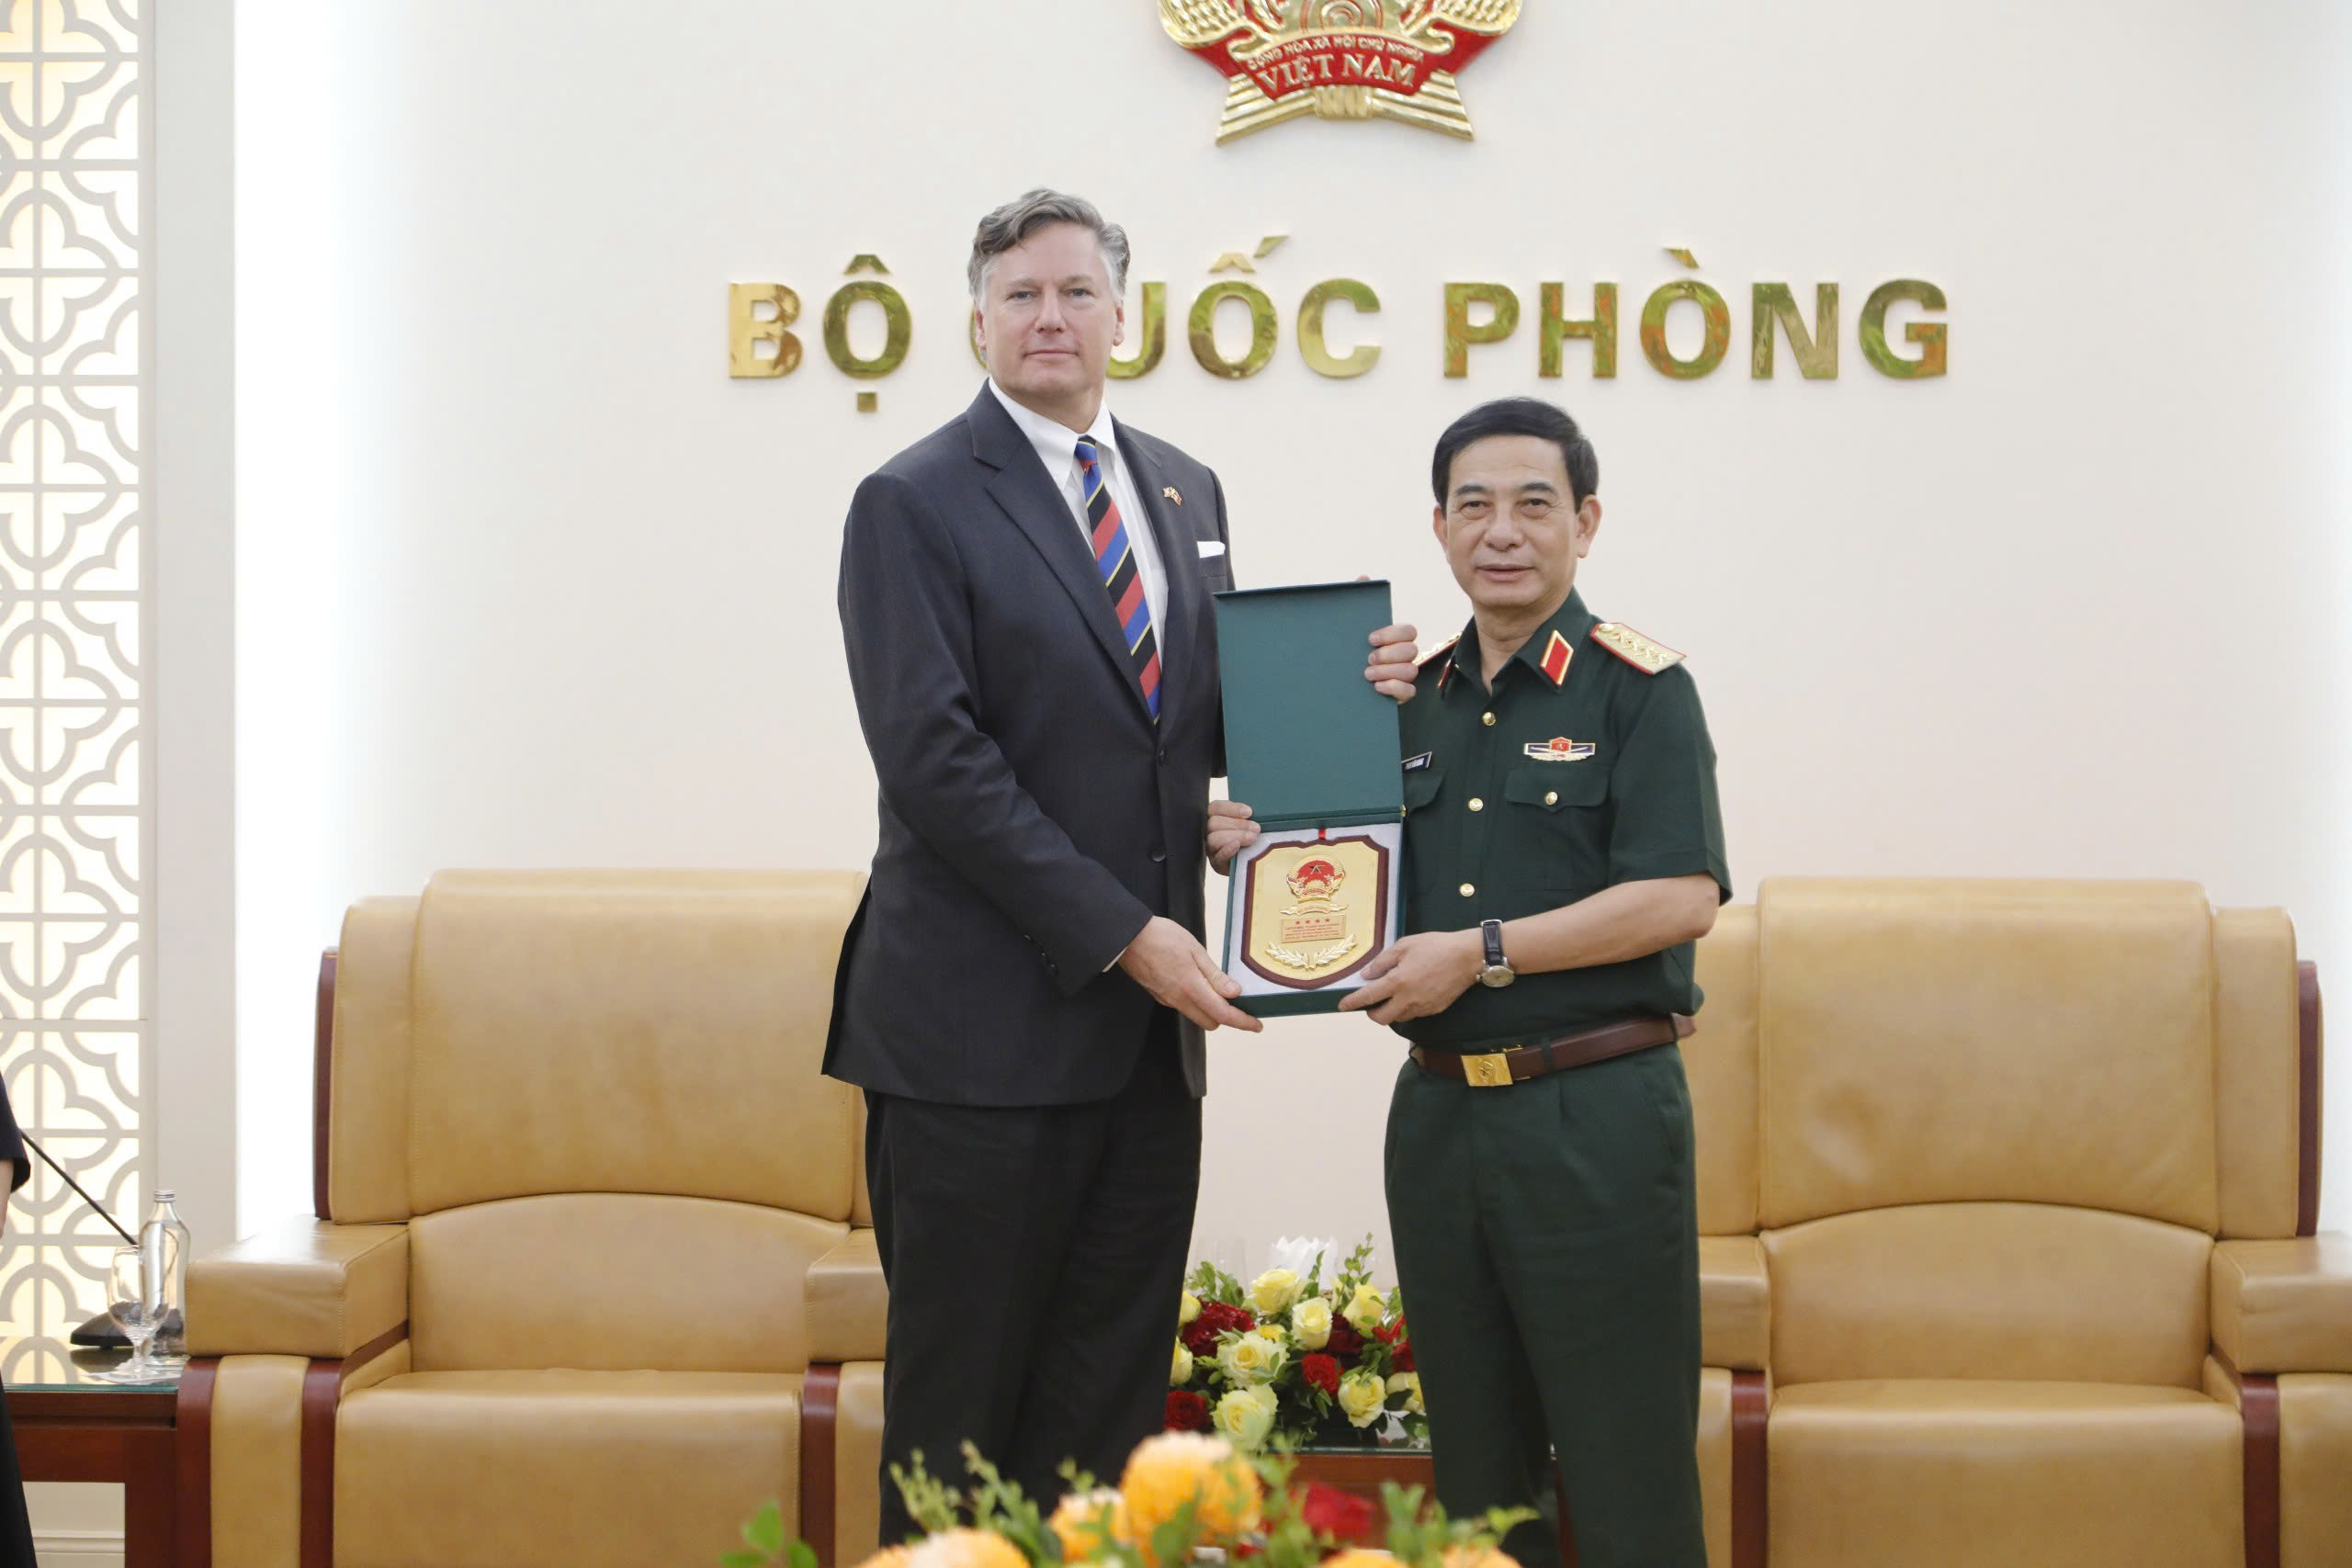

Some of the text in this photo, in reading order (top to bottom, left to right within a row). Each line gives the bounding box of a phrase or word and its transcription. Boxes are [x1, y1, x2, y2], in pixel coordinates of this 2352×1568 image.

[1256, 53, 1416, 91] VIỆT NAM
[729, 234, 1947, 412] BỘ UỐC PHÒNG
